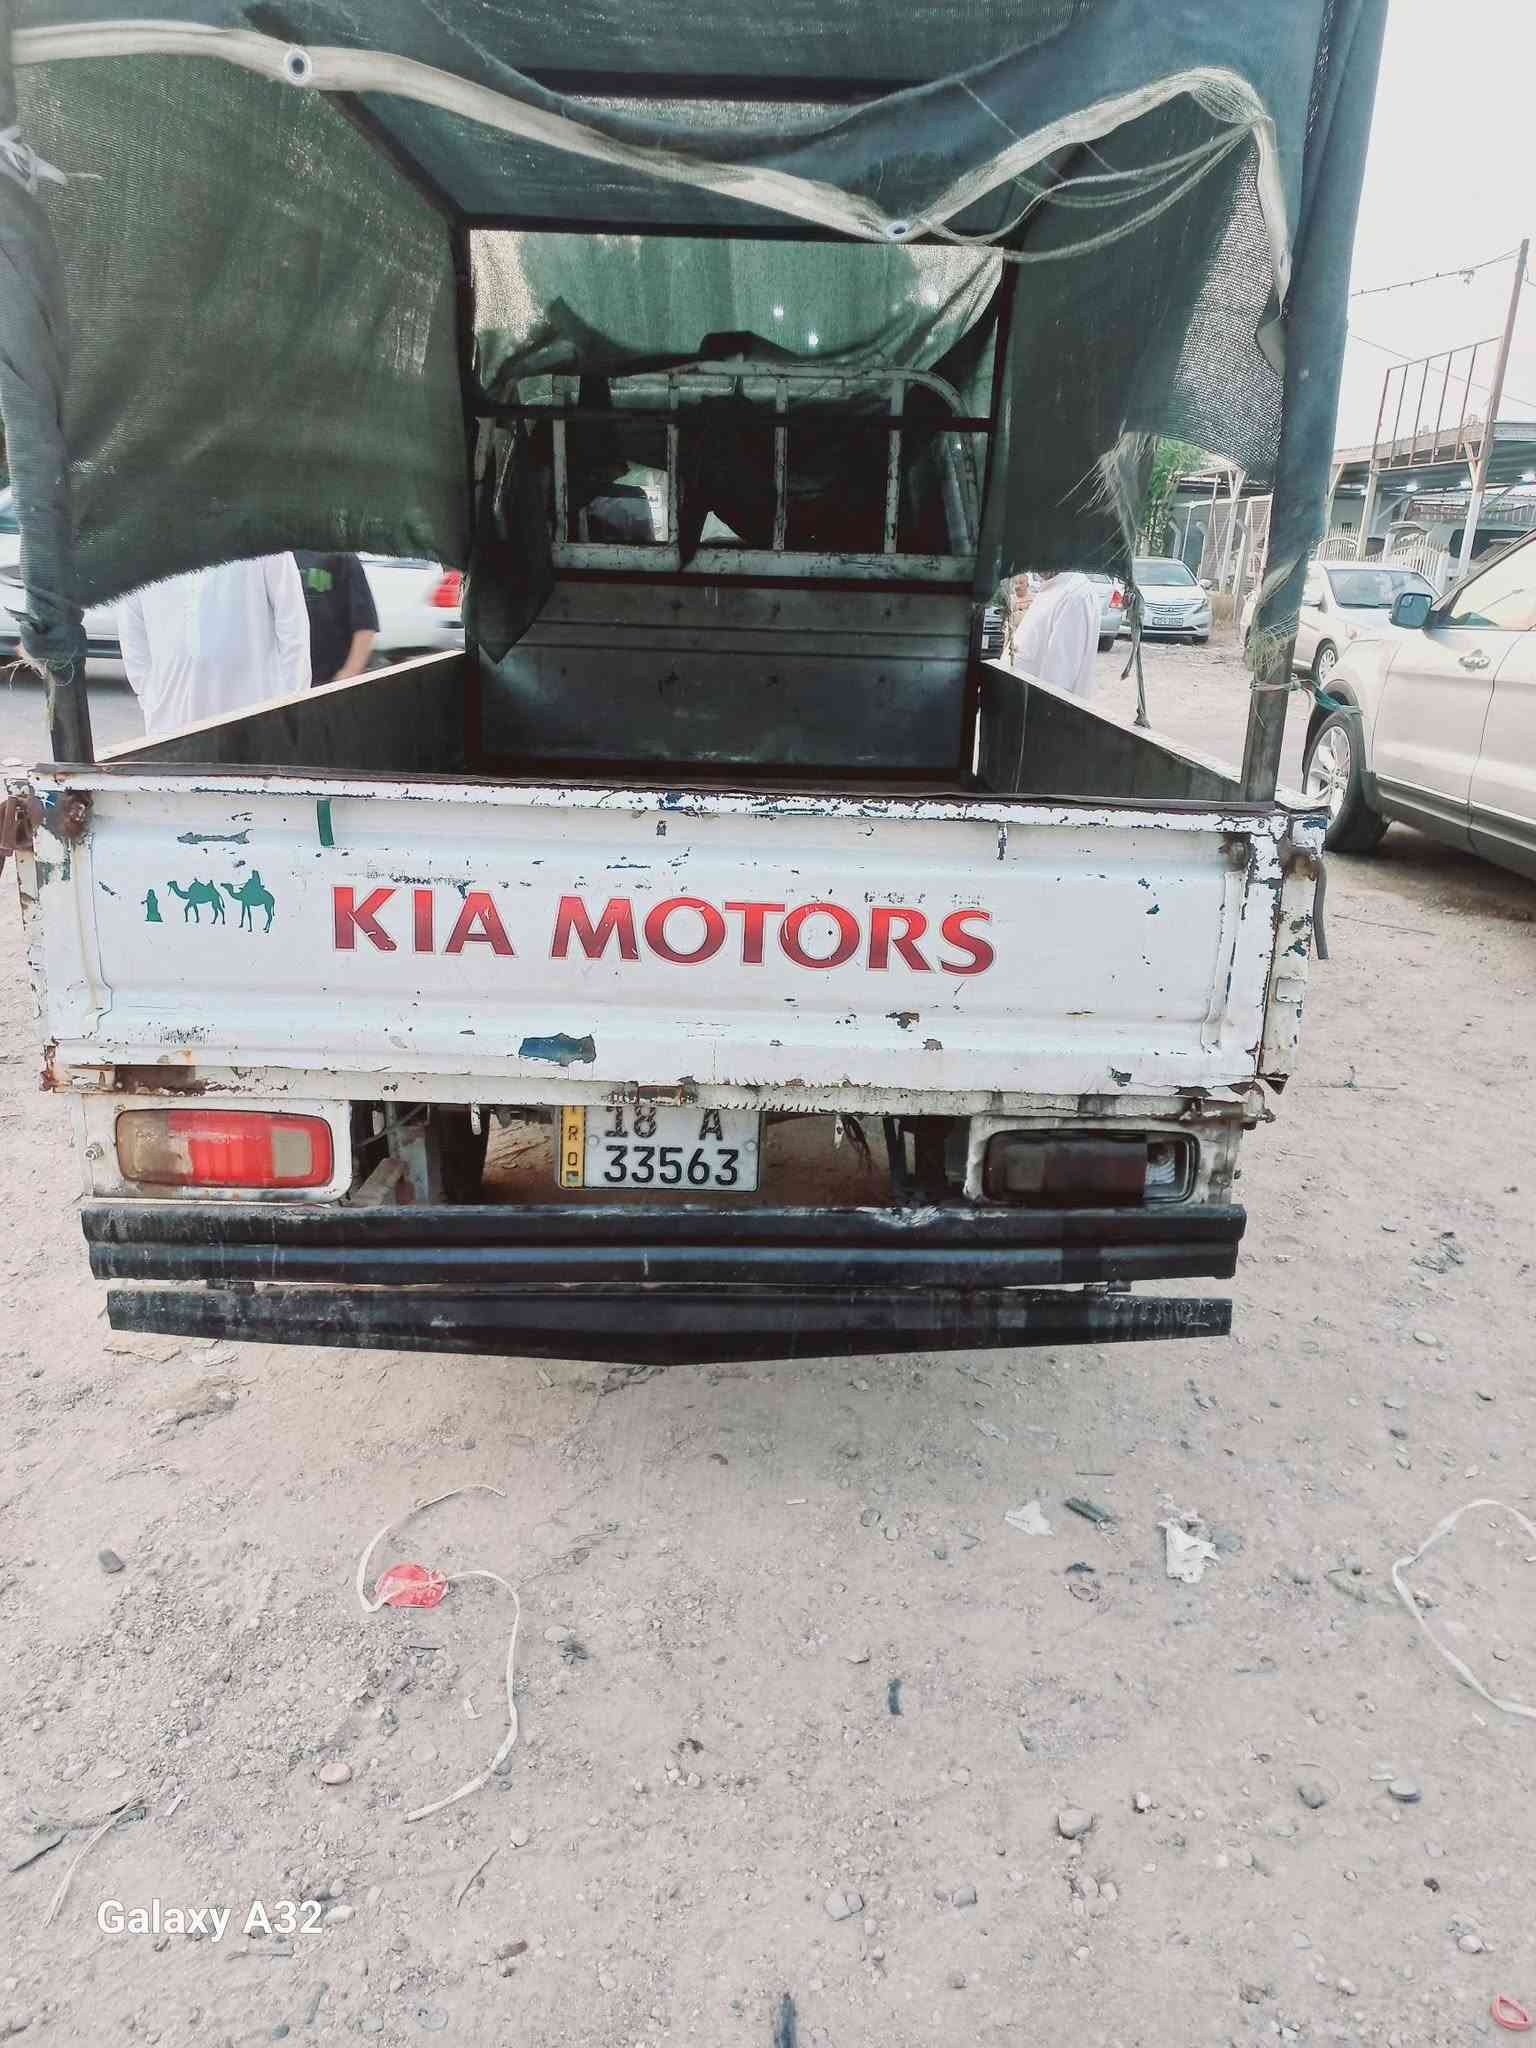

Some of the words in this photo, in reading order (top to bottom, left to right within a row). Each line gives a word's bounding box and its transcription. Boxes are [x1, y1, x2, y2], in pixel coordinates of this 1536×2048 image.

[331, 885, 518, 957] KIA
[547, 894, 997, 974] MOTORS
[604, 1106, 657, 1138] 18
[698, 1109, 723, 1141] A
[604, 1145, 739, 1185] 33563
